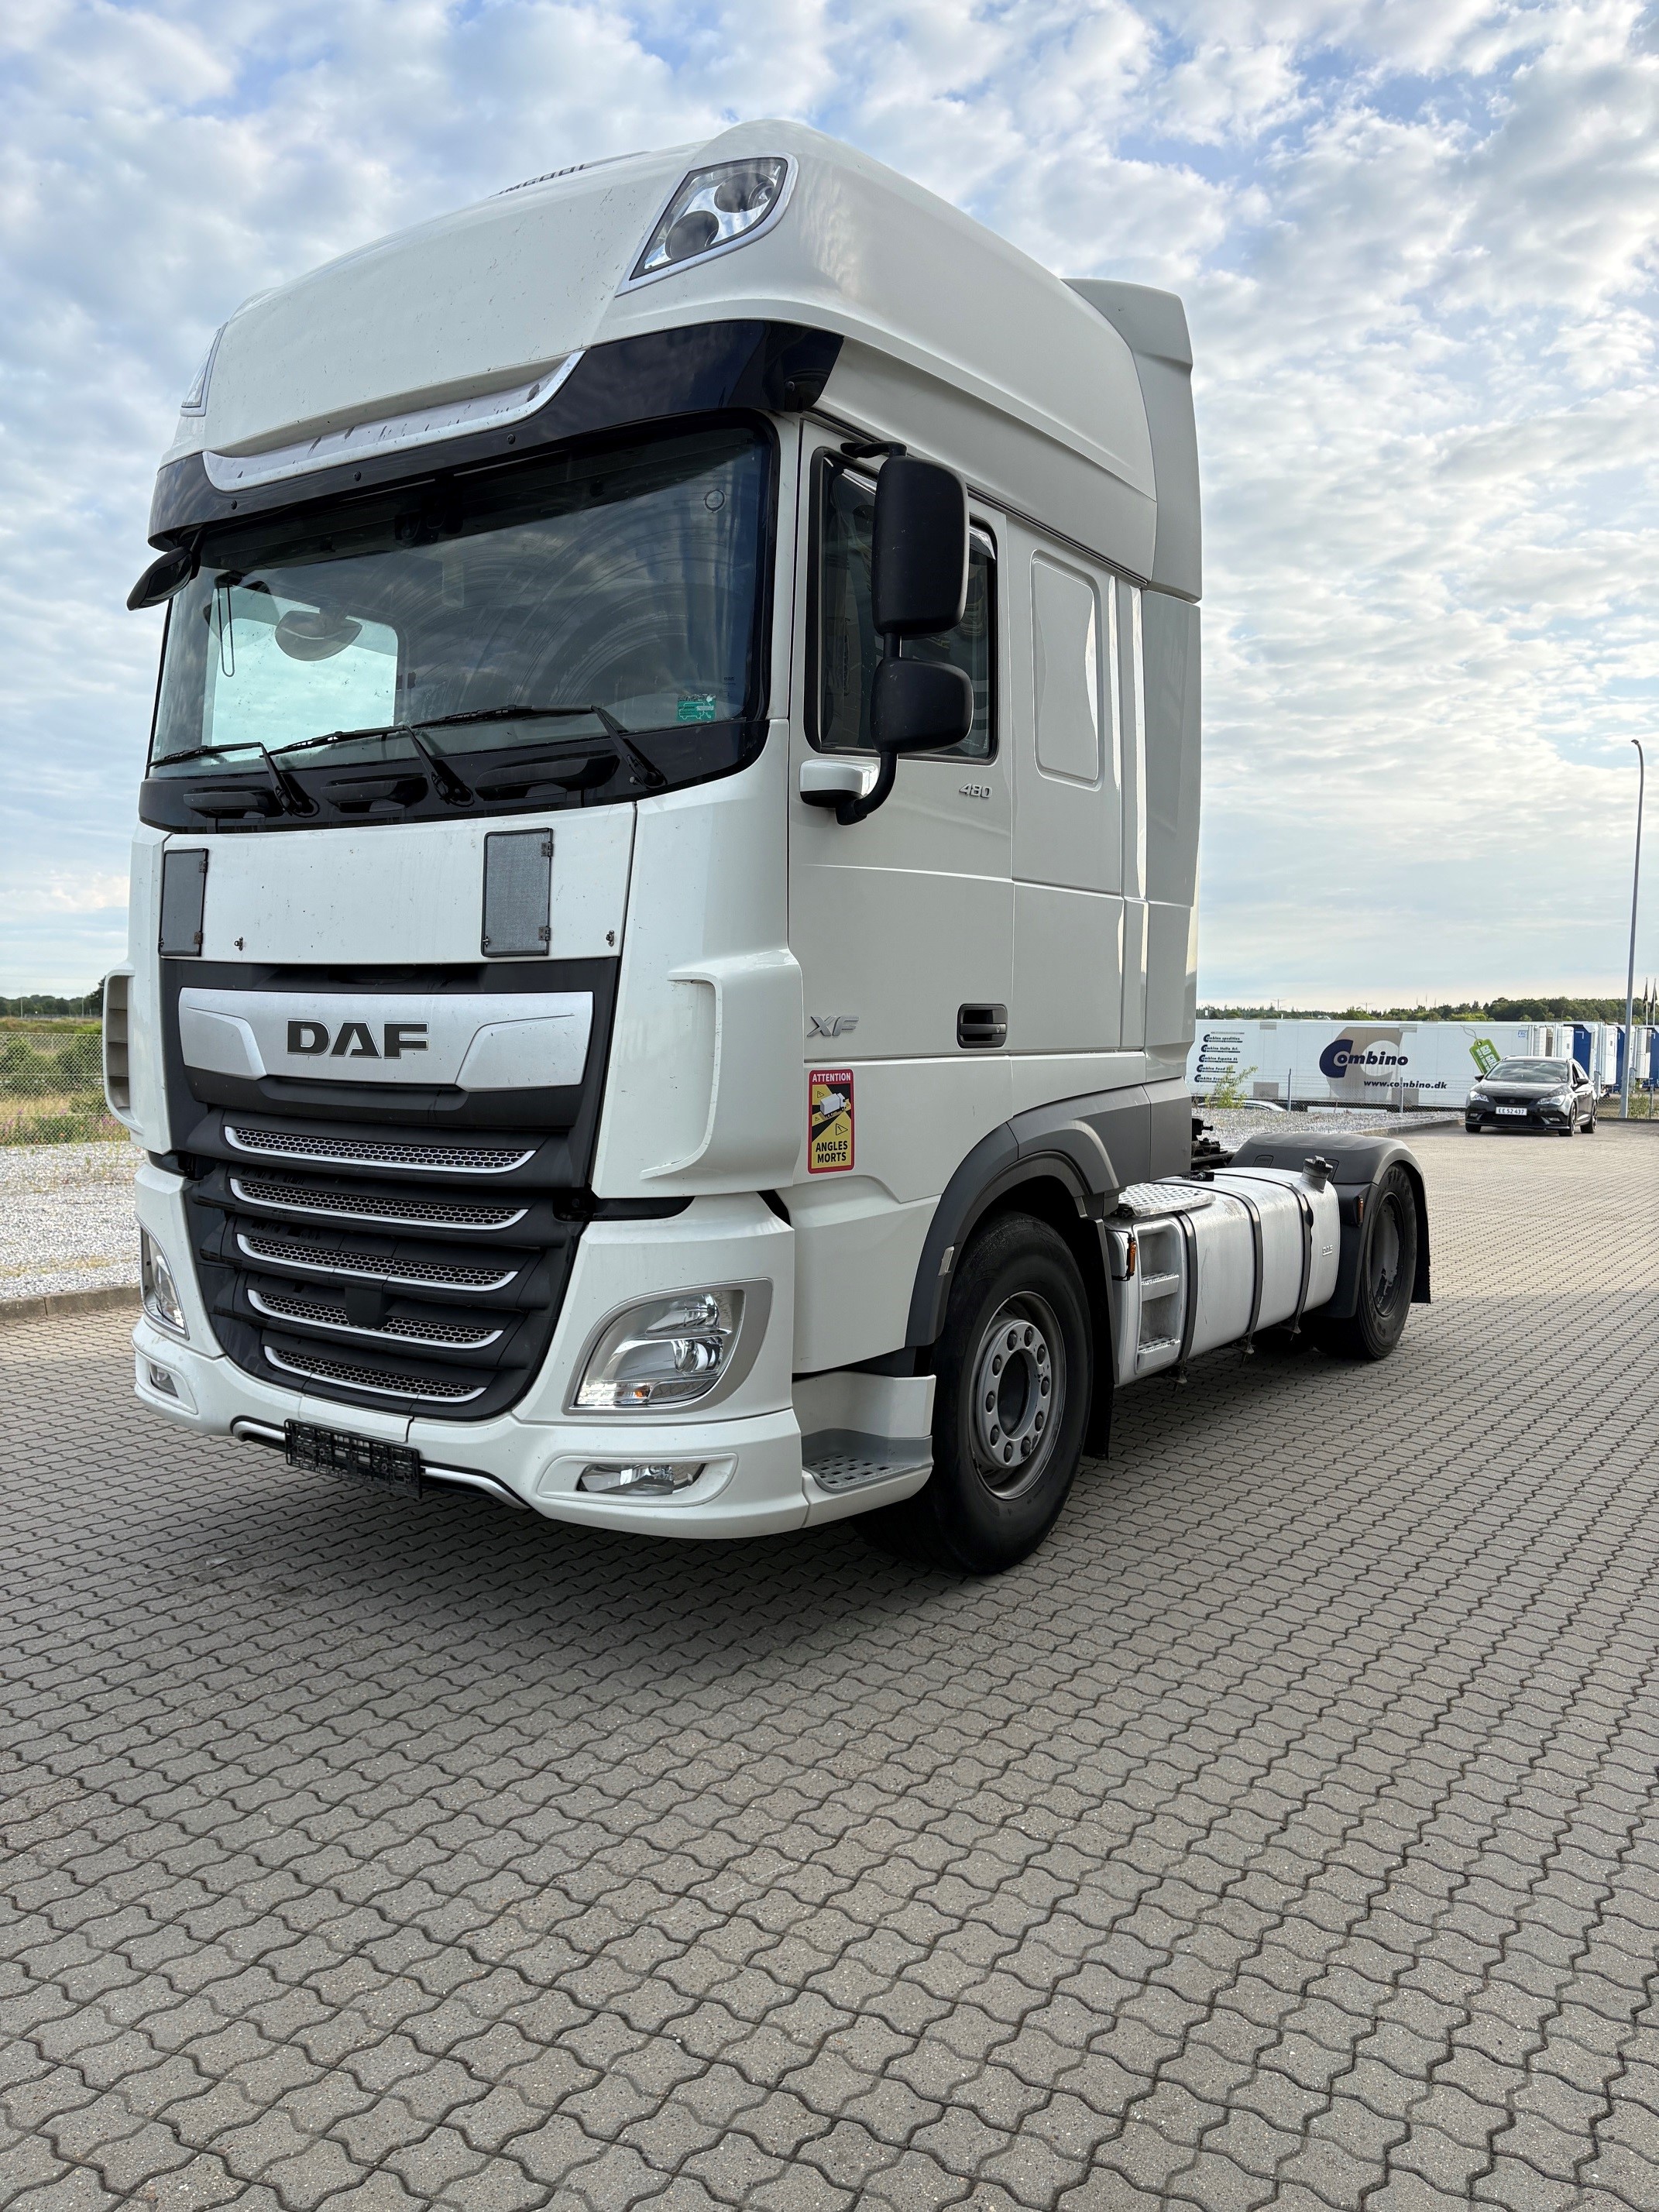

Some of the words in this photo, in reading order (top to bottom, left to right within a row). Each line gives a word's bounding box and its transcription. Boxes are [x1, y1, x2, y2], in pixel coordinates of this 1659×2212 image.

[959, 783, 992, 799] 480
[806, 1015, 860, 1037] XF
[287, 1018, 429, 1059] DAF
[1319, 1039, 1408, 1078] Combino
[812, 1073, 851, 1082] ATTENTION
[1363, 1080, 1448, 1090] www.combino.dk
[816, 1140, 848, 1152] ANGLES
[817, 1152, 847, 1163] MORTS
